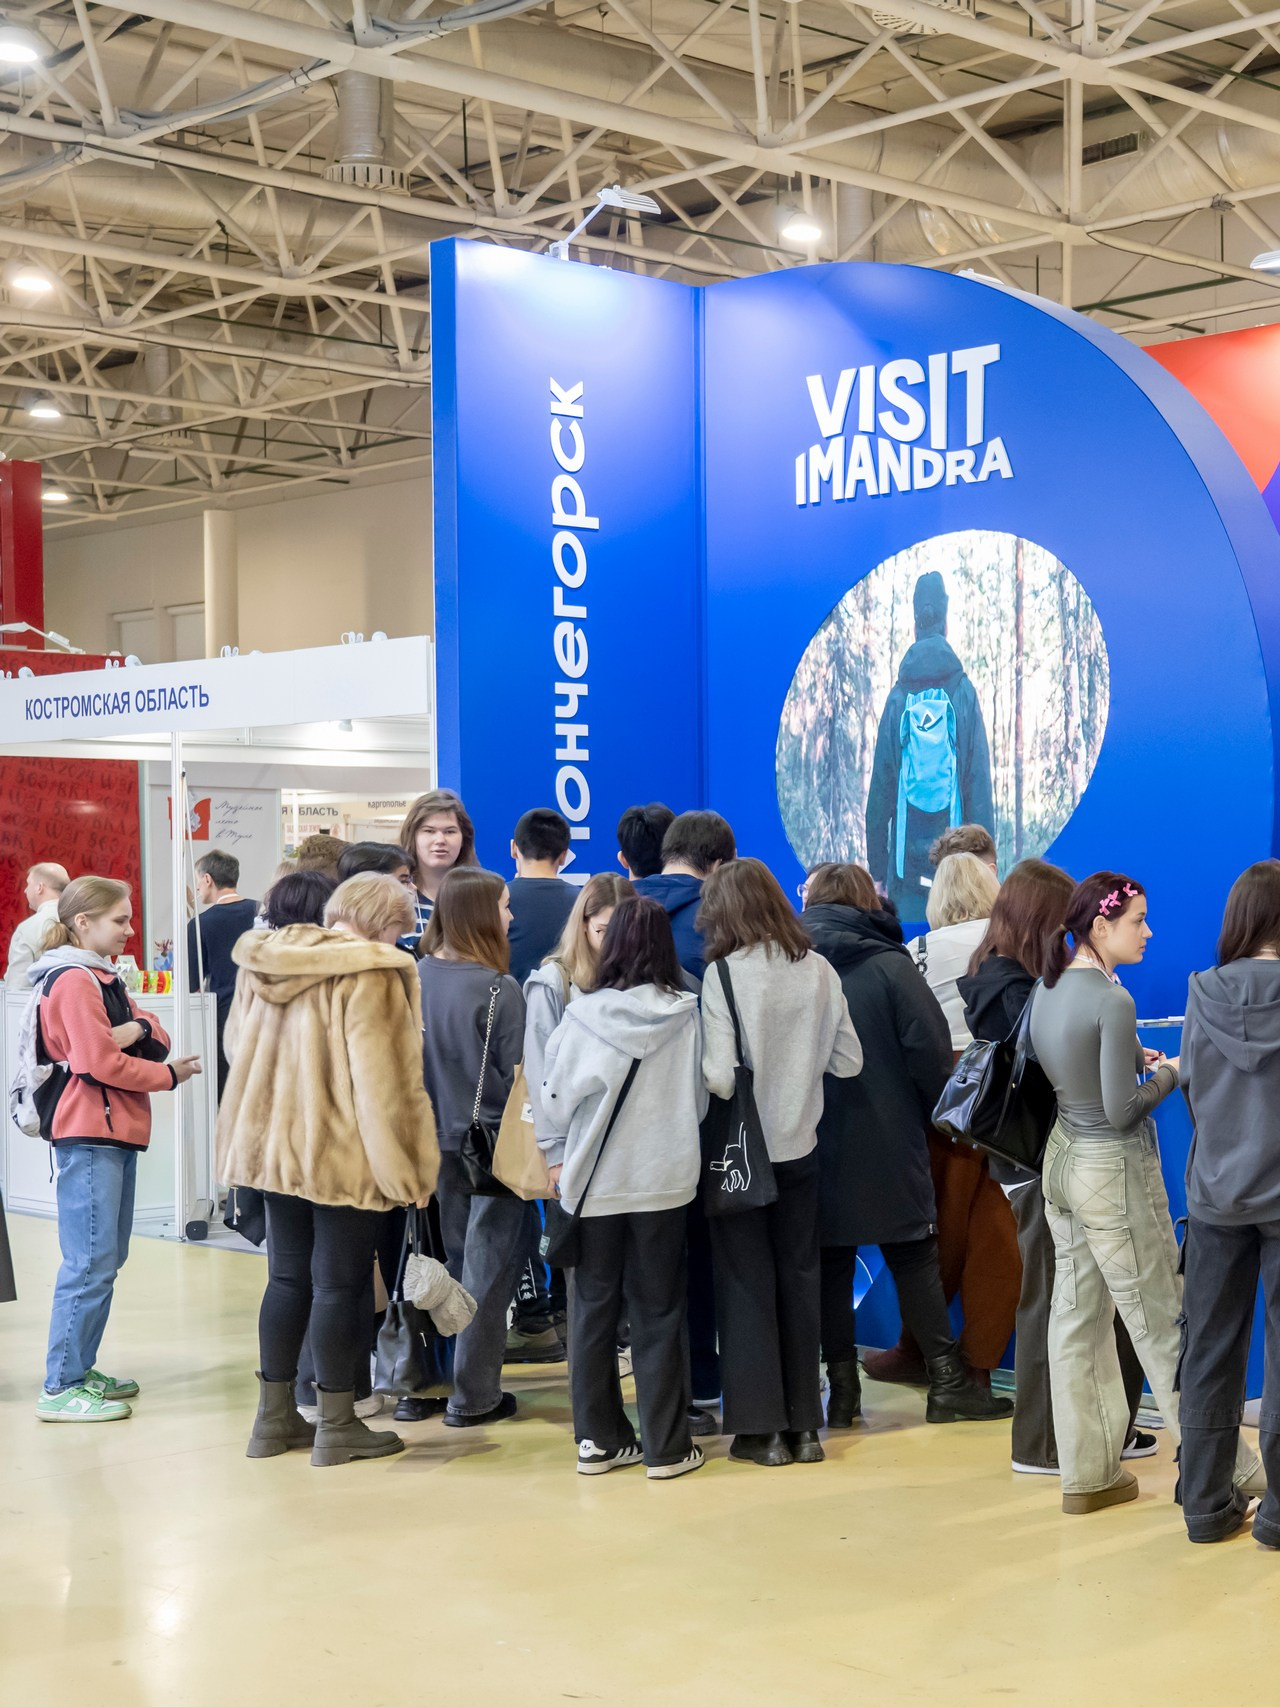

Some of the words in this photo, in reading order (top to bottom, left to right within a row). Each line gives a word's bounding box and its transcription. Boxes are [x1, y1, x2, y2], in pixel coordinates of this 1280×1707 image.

[806, 343, 1001, 450] VISIT
[795, 435, 1014, 506] IMANDRA
[25, 691, 131, 721] КОСТРОМСКАЯ
[135, 684, 210, 713] ОБЛАСТЬ
[290, 806, 339, 816] БЛАСТЬ
